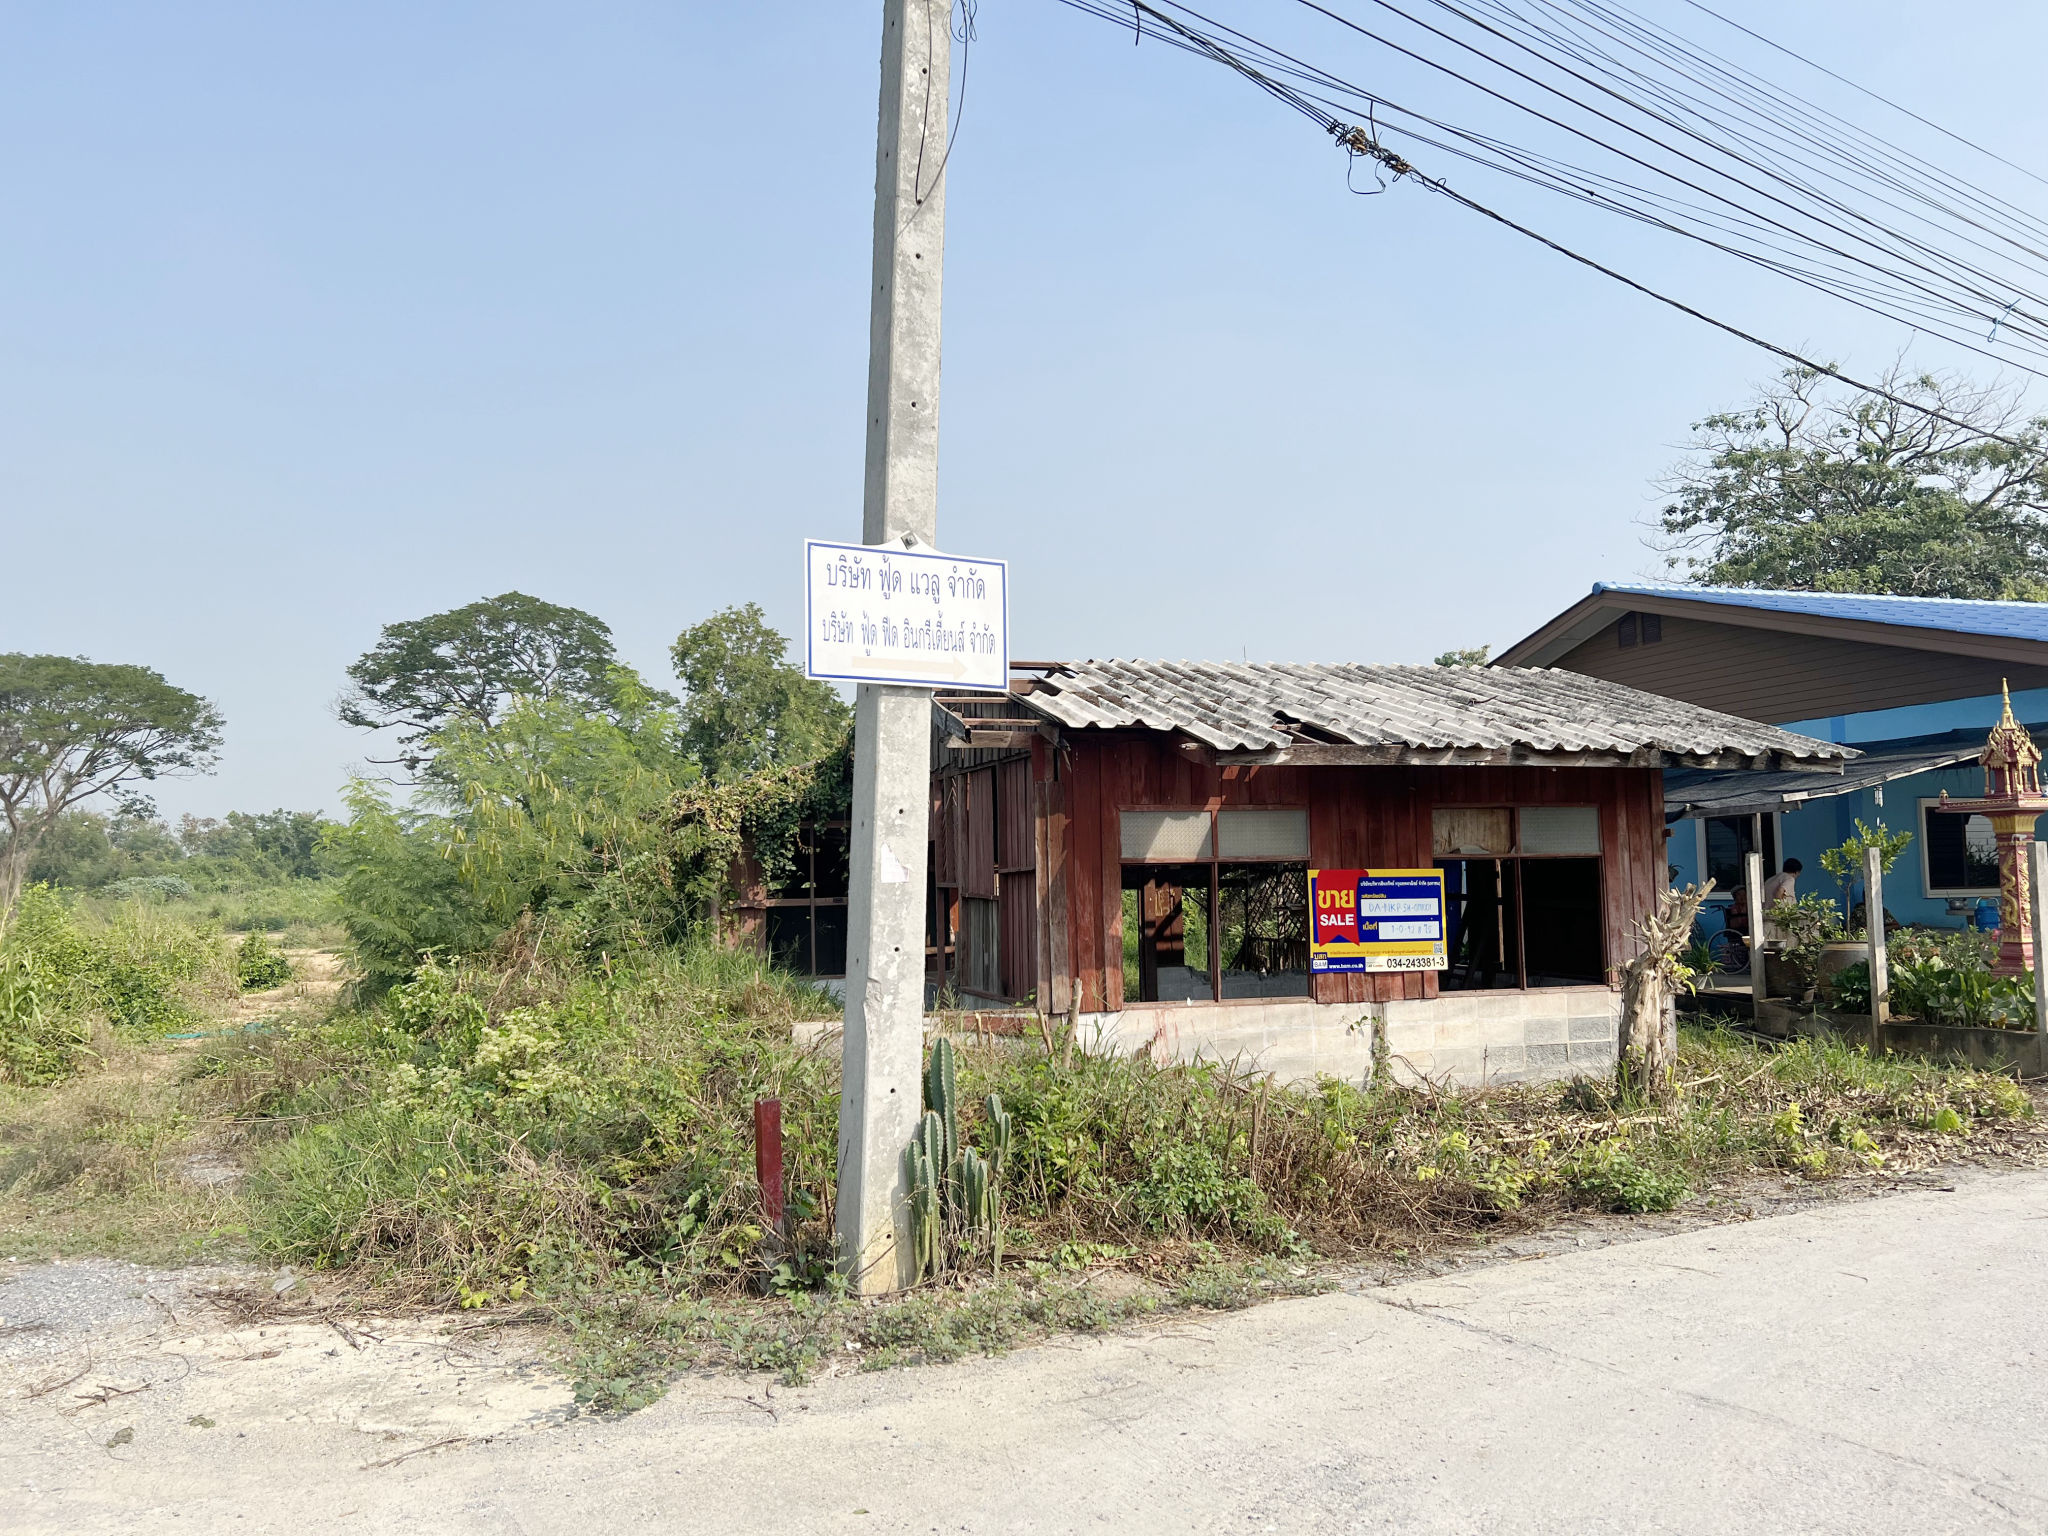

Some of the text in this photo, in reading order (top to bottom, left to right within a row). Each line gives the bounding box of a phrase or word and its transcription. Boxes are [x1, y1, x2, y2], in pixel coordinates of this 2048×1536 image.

[827, 555, 986, 604] บริษัท ฟู้ด แวลู จำกัด
[822, 611, 854, 644] บริษัท
[861, 610, 878, 656] ฟู้ด
[969, 622, 996, 655] จำกัด
[1318, 889, 1355, 909] ขาย
[1320, 914, 1355, 926] SALE
[1387, 957, 1445, 968] 034-243381-3
